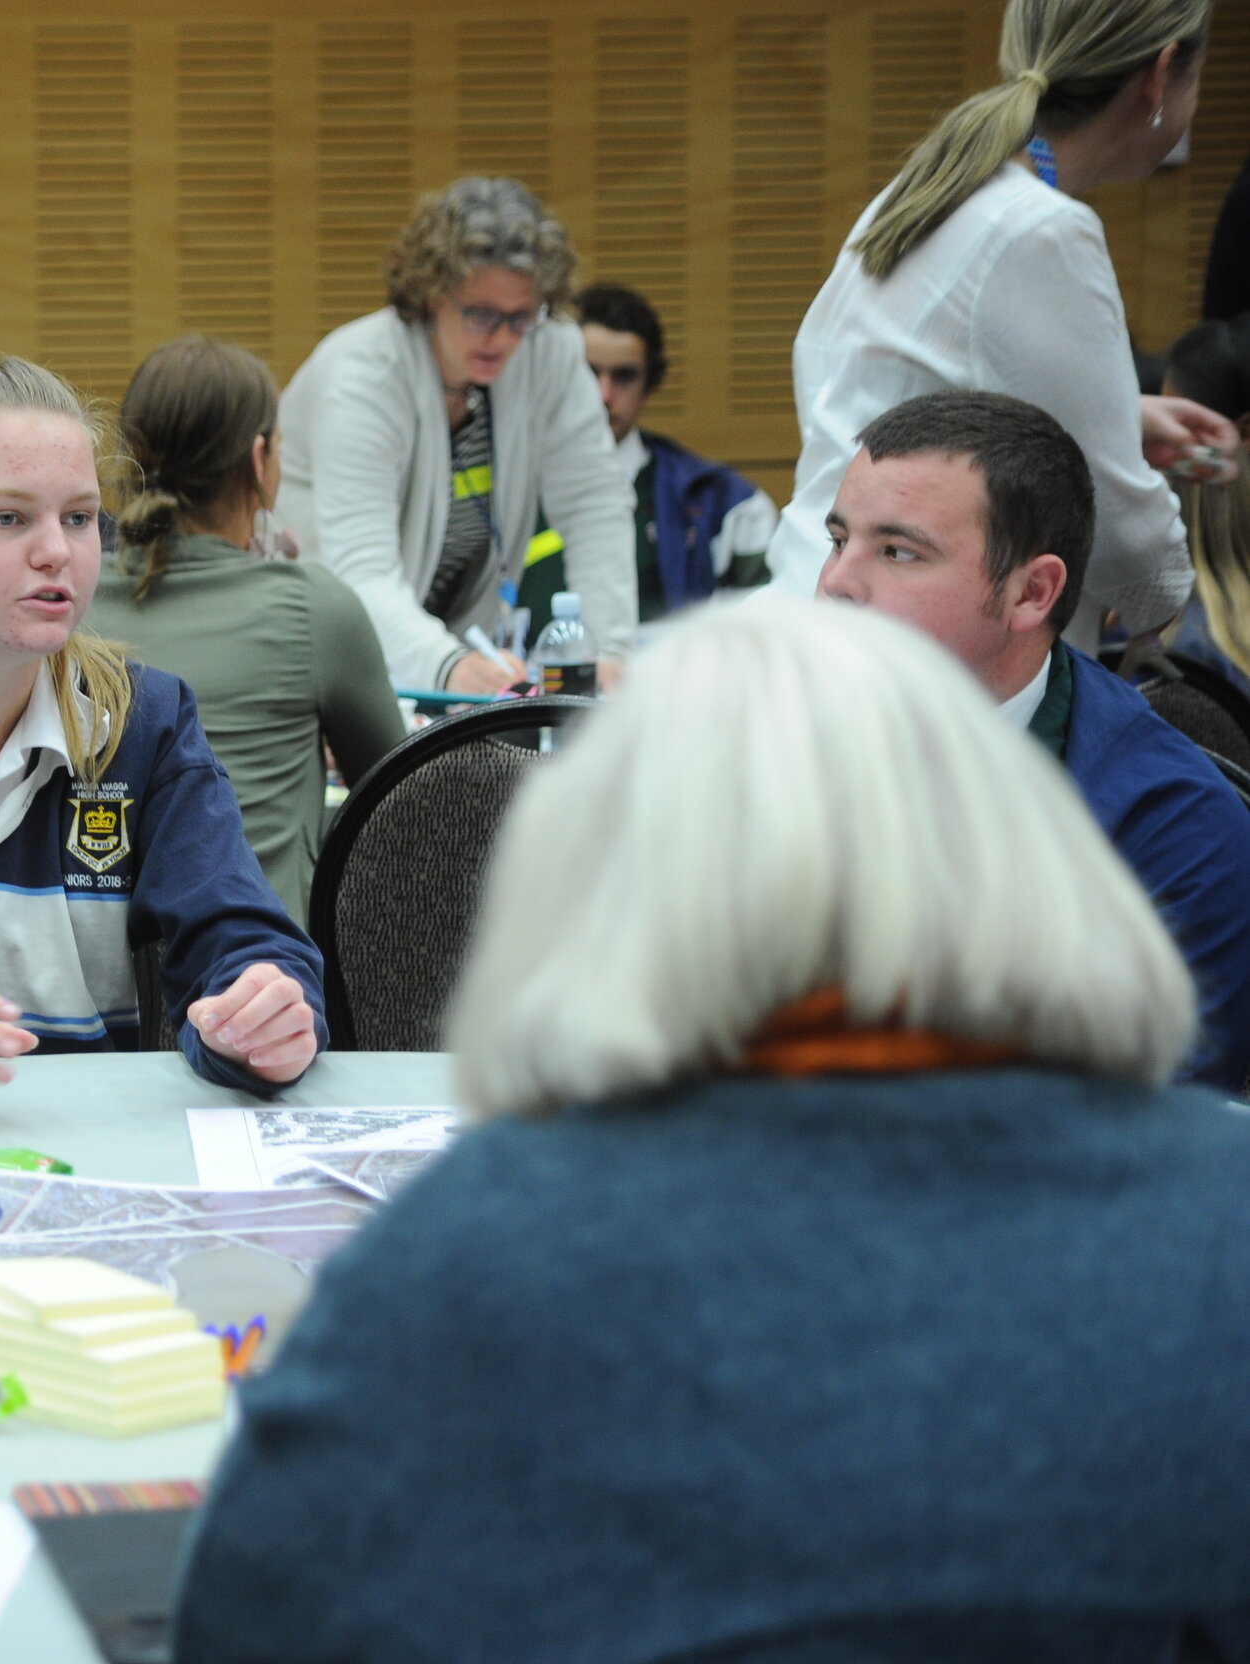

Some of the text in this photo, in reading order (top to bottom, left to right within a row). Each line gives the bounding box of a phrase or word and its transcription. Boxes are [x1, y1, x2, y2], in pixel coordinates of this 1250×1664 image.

[101, 781, 129, 791] WAGGA
[97, 790, 125, 800] SCHOOL
[64, 873, 93, 887] NIORS
